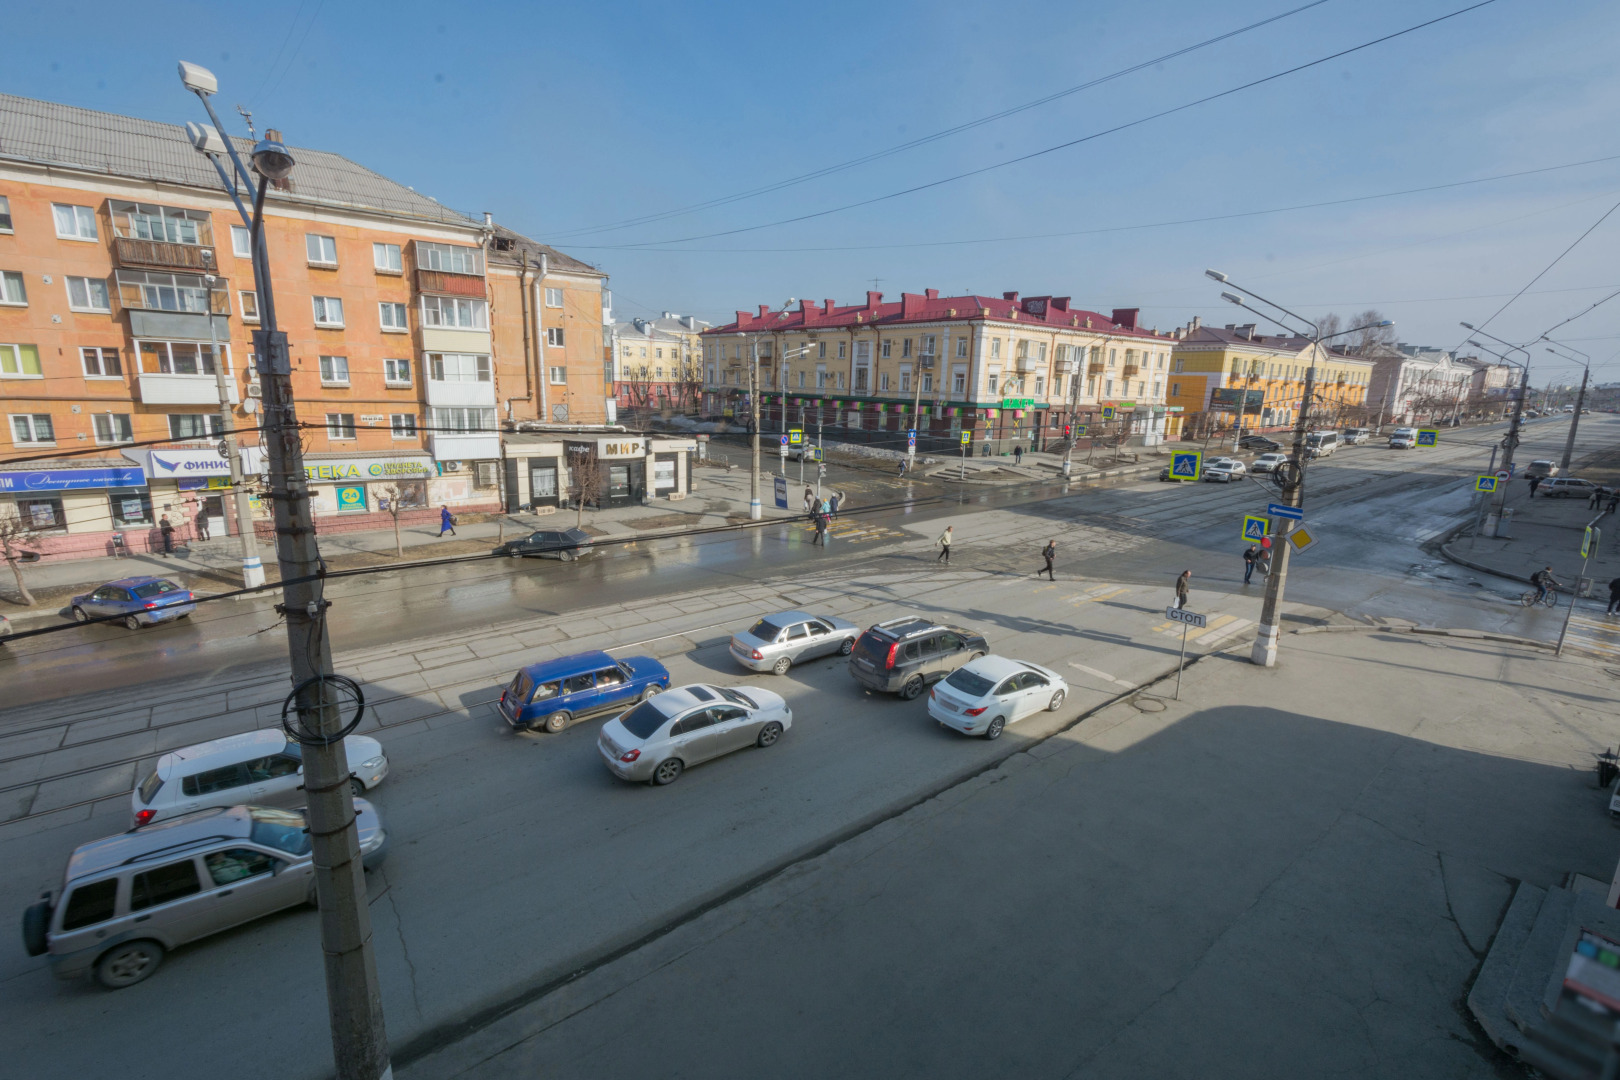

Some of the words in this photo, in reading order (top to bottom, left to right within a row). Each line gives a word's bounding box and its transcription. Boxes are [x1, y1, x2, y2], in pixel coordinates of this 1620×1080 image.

[568, 445, 590, 454] кафе
[344, 492, 358, 500] 24
[1170, 609, 1202, 625] СТОП
